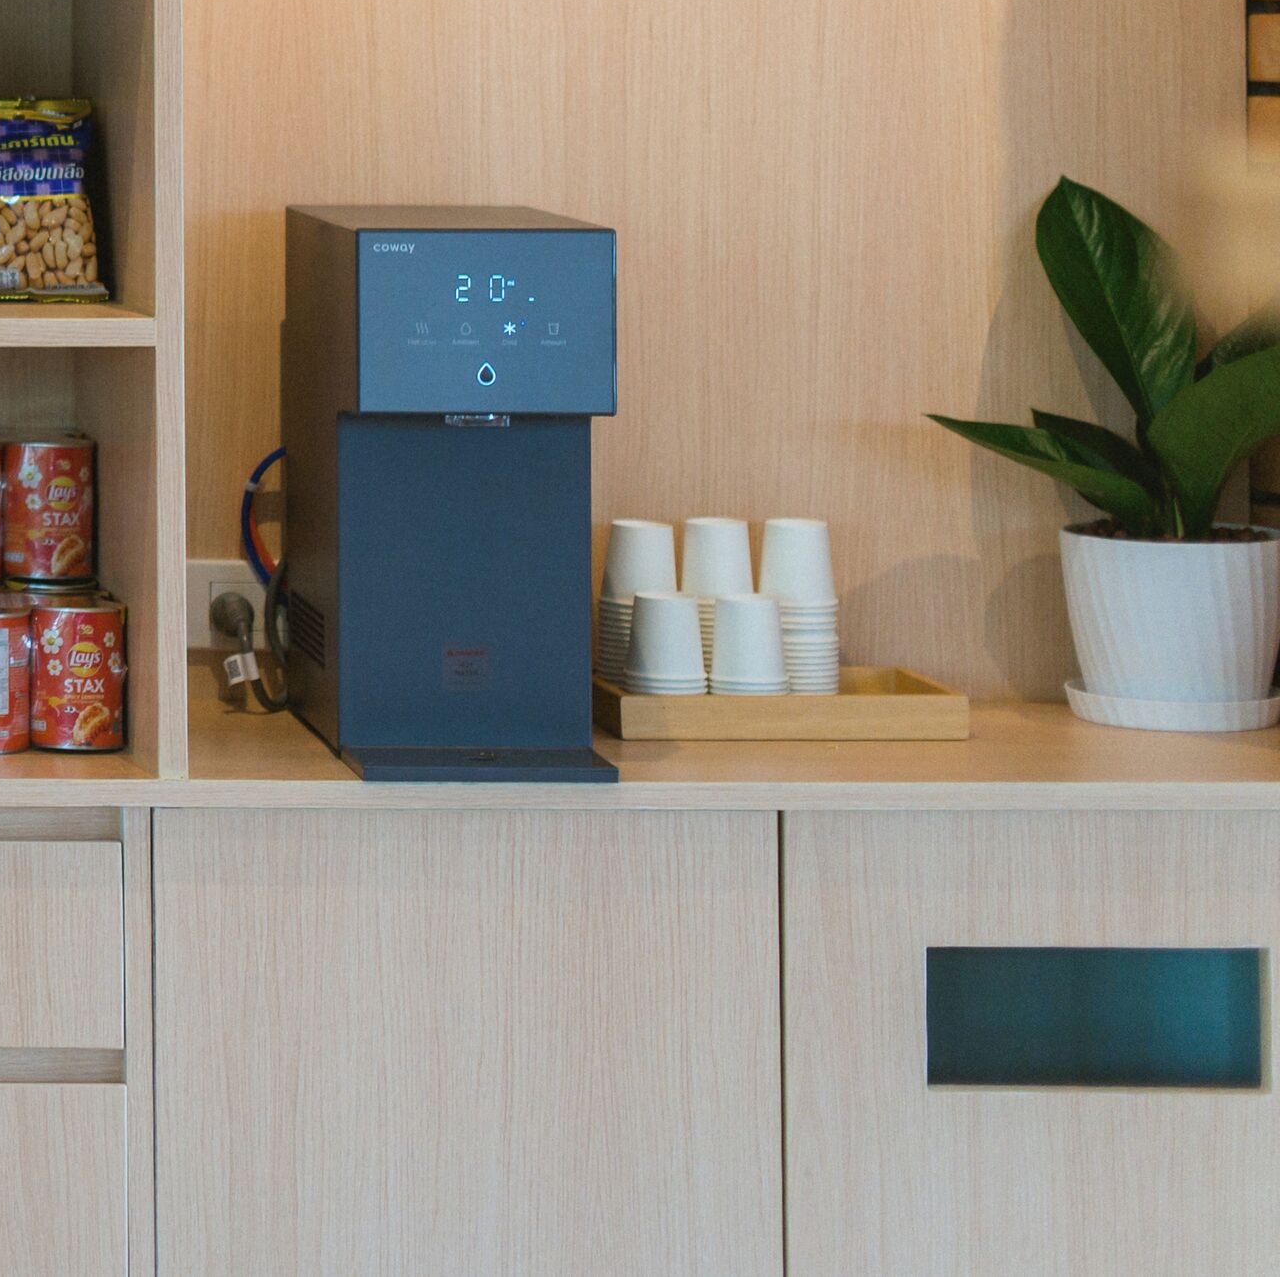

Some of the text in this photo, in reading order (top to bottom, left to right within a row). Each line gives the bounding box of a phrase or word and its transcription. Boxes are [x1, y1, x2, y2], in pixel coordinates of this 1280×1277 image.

[373, 242, 415, 254] coway
[48, 484, 76, 502] Lay's
[43, 512, 79, 526] STAX
[70, 650, 100, 668] Lay's
[64, 678, 104, 693] STAX
